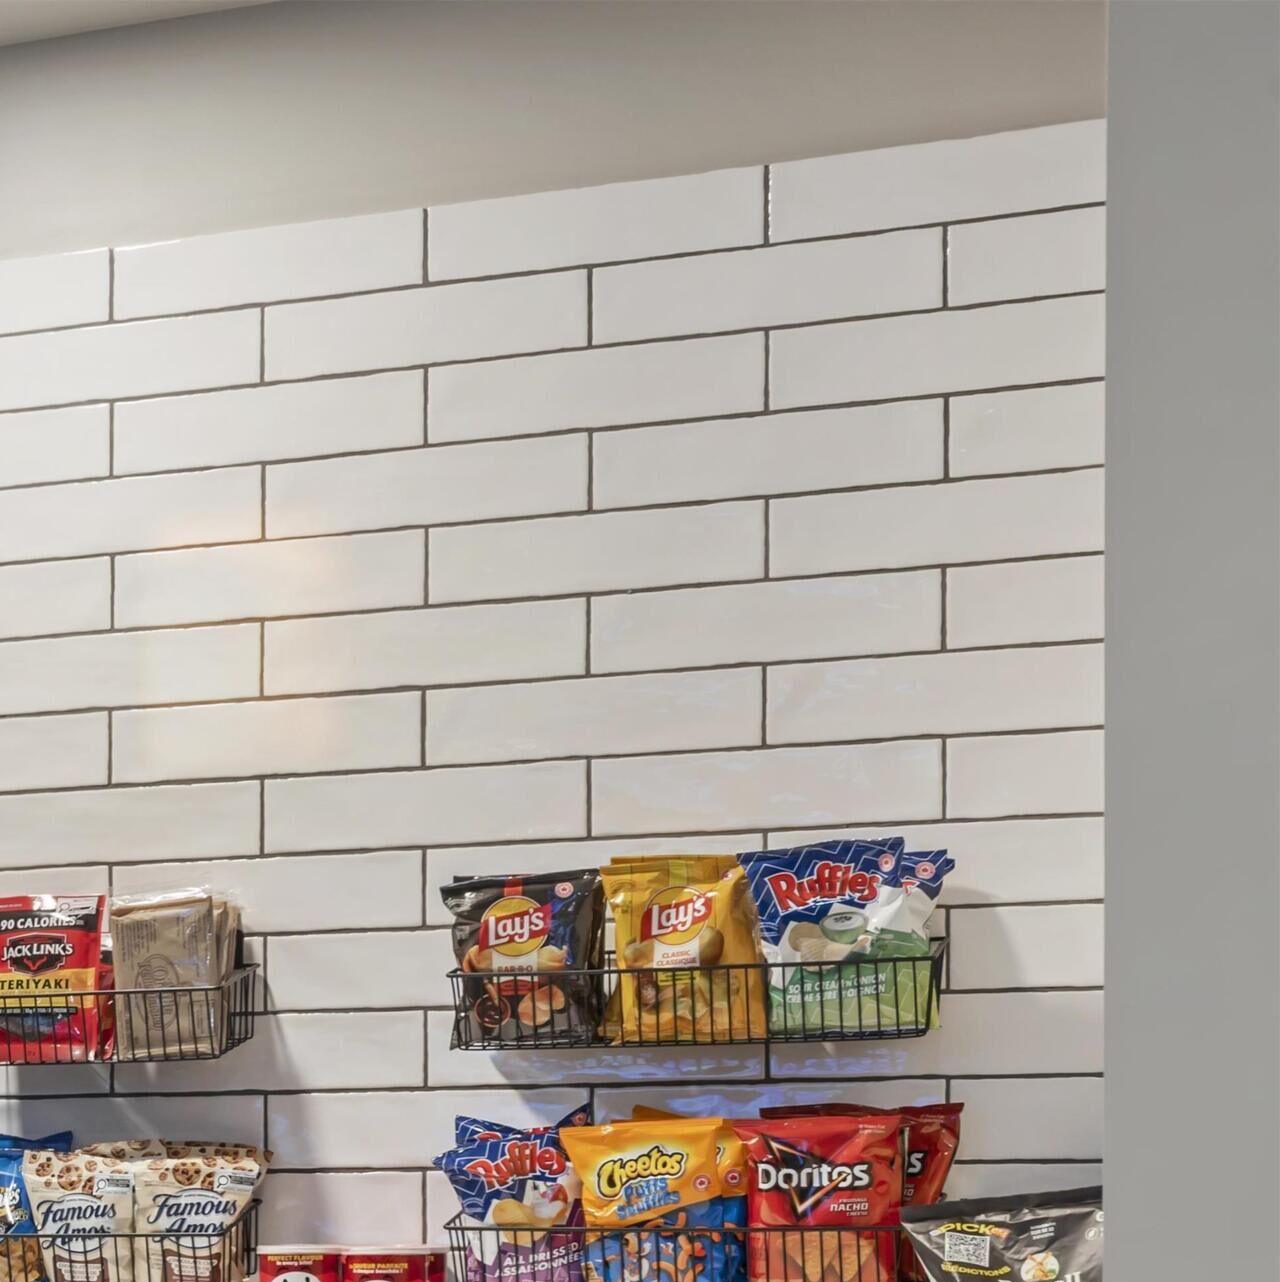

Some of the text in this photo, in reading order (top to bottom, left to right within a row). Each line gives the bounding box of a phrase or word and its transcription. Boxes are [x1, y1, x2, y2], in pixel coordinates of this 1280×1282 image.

[765, 860, 882, 915] Ruffles
[0, 919, 15, 930] 90
[488, 908, 544, 945] Lay's
[651, 895, 706, 936] Lay's
[1, 945, 31, 961] JACK
[0, 978, 70, 990] TERIYAKI
[464, 1141, 568, 1191] Ruffles
[598, 1145, 686, 1198] Cheetos
[757, 1163, 871, 1190] Doritos
[37, 1199, 117, 1231] Famous
[147, 1193, 239, 1224] Famous
